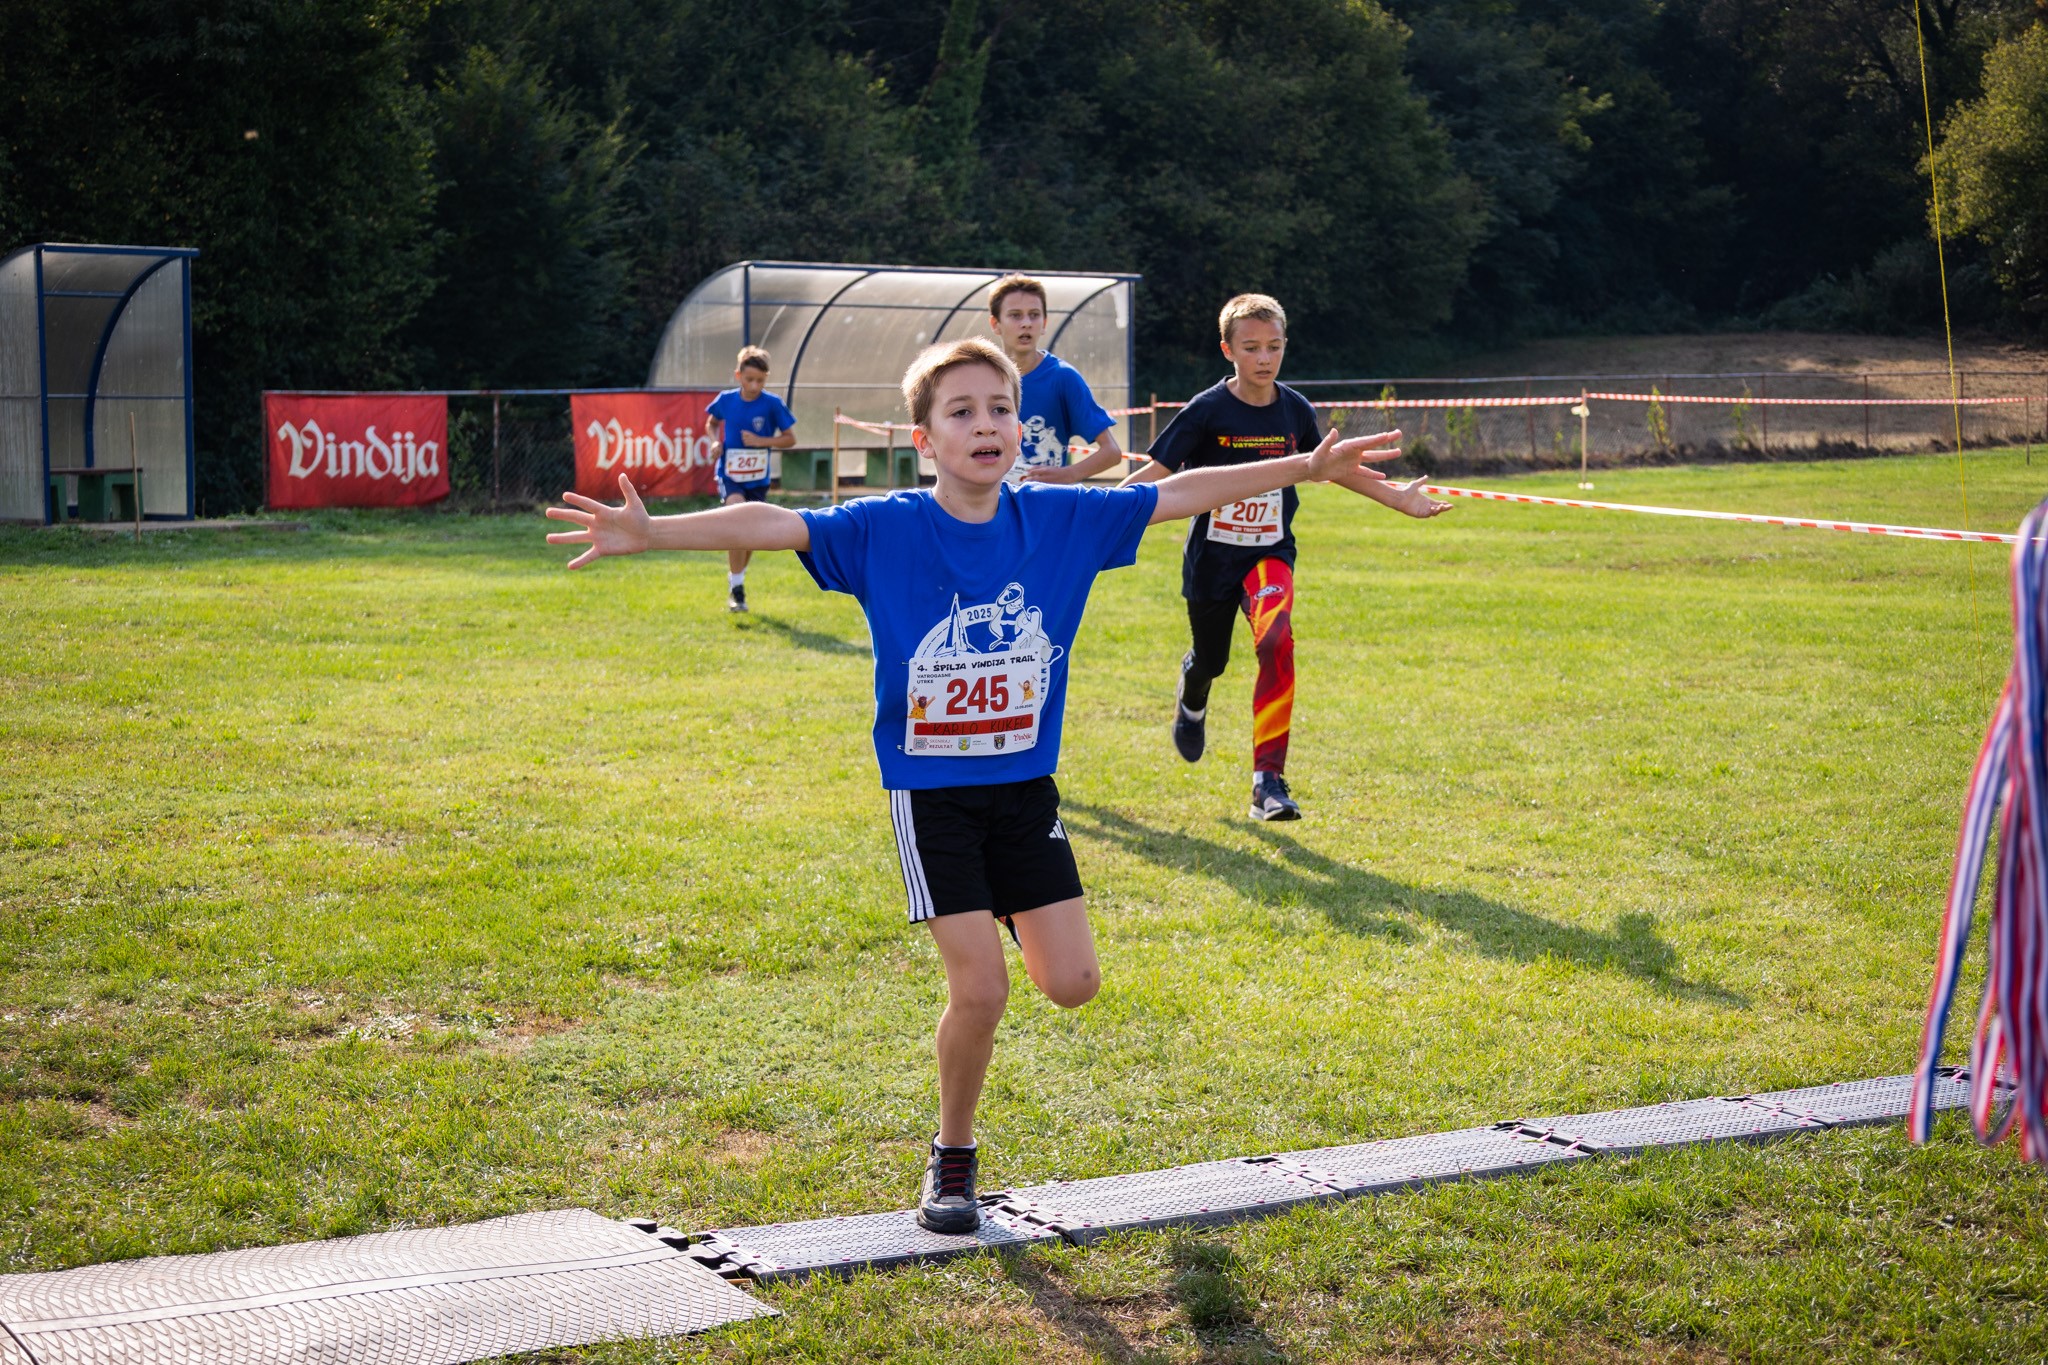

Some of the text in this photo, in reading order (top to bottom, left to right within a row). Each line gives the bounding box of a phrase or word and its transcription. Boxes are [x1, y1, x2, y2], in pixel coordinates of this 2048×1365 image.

[277, 418, 440, 485] Vindija
[586, 417, 713, 473] Vindija
[737, 456, 758, 468] 247
[1232, 501, 1268, 523] 207
[917, 664, 928, 672] 4.
[946, 674, 1009, 716] 245
[932, 722, 978, 736] KARLO
